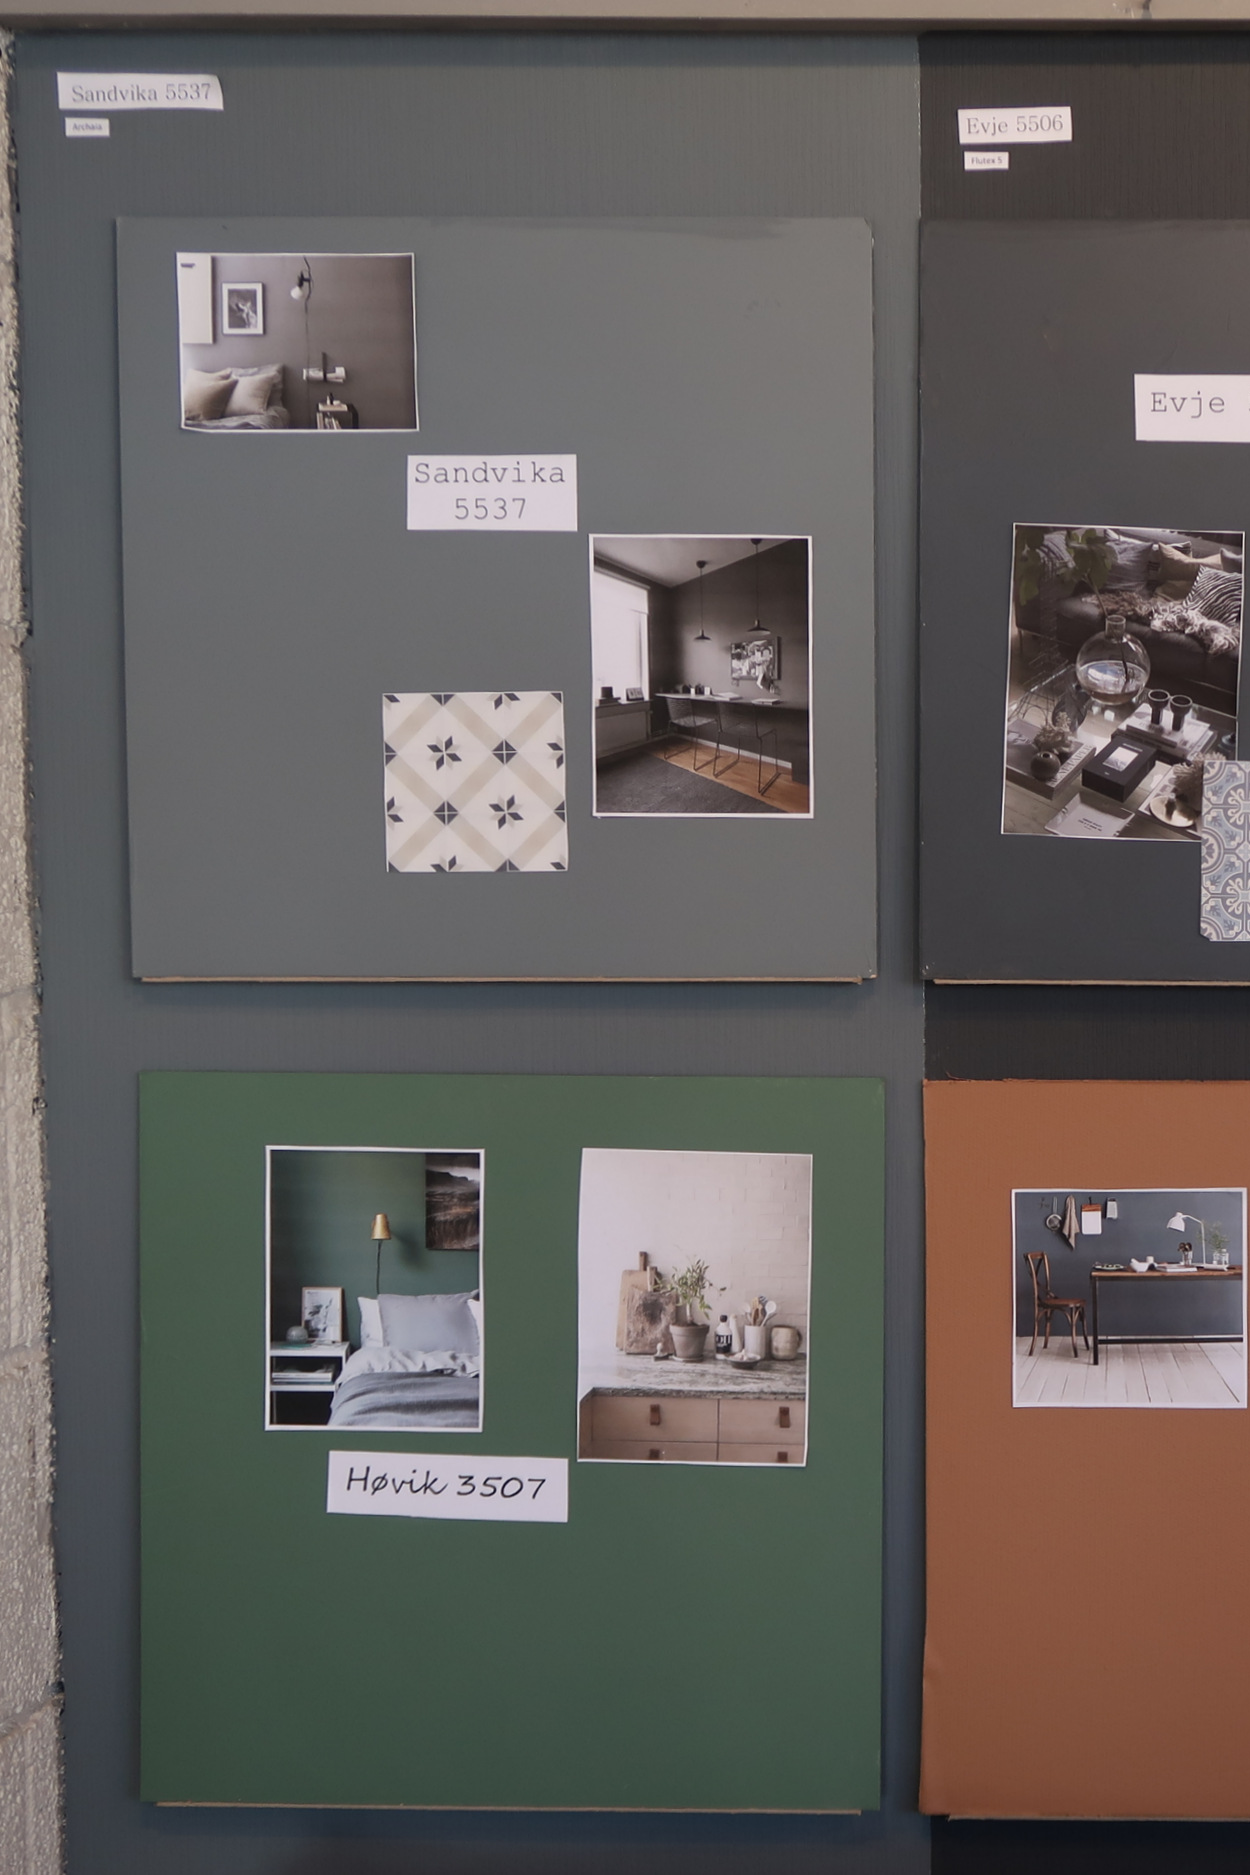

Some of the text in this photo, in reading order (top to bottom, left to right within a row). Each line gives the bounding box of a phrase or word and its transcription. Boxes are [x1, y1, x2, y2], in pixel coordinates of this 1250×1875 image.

[71, 82, 211, 103] Sandvika 5537
[966, 114, 1063, 137] Evje 5506
[997, 156, 1003, 165] 5
[1150, 390, 1225, 419] Evje
[414, 460, 565, 484] Sandvika
[455, 497, 526, 521] 5537
[346, 1465, 546, 1500] Høvik 3507
